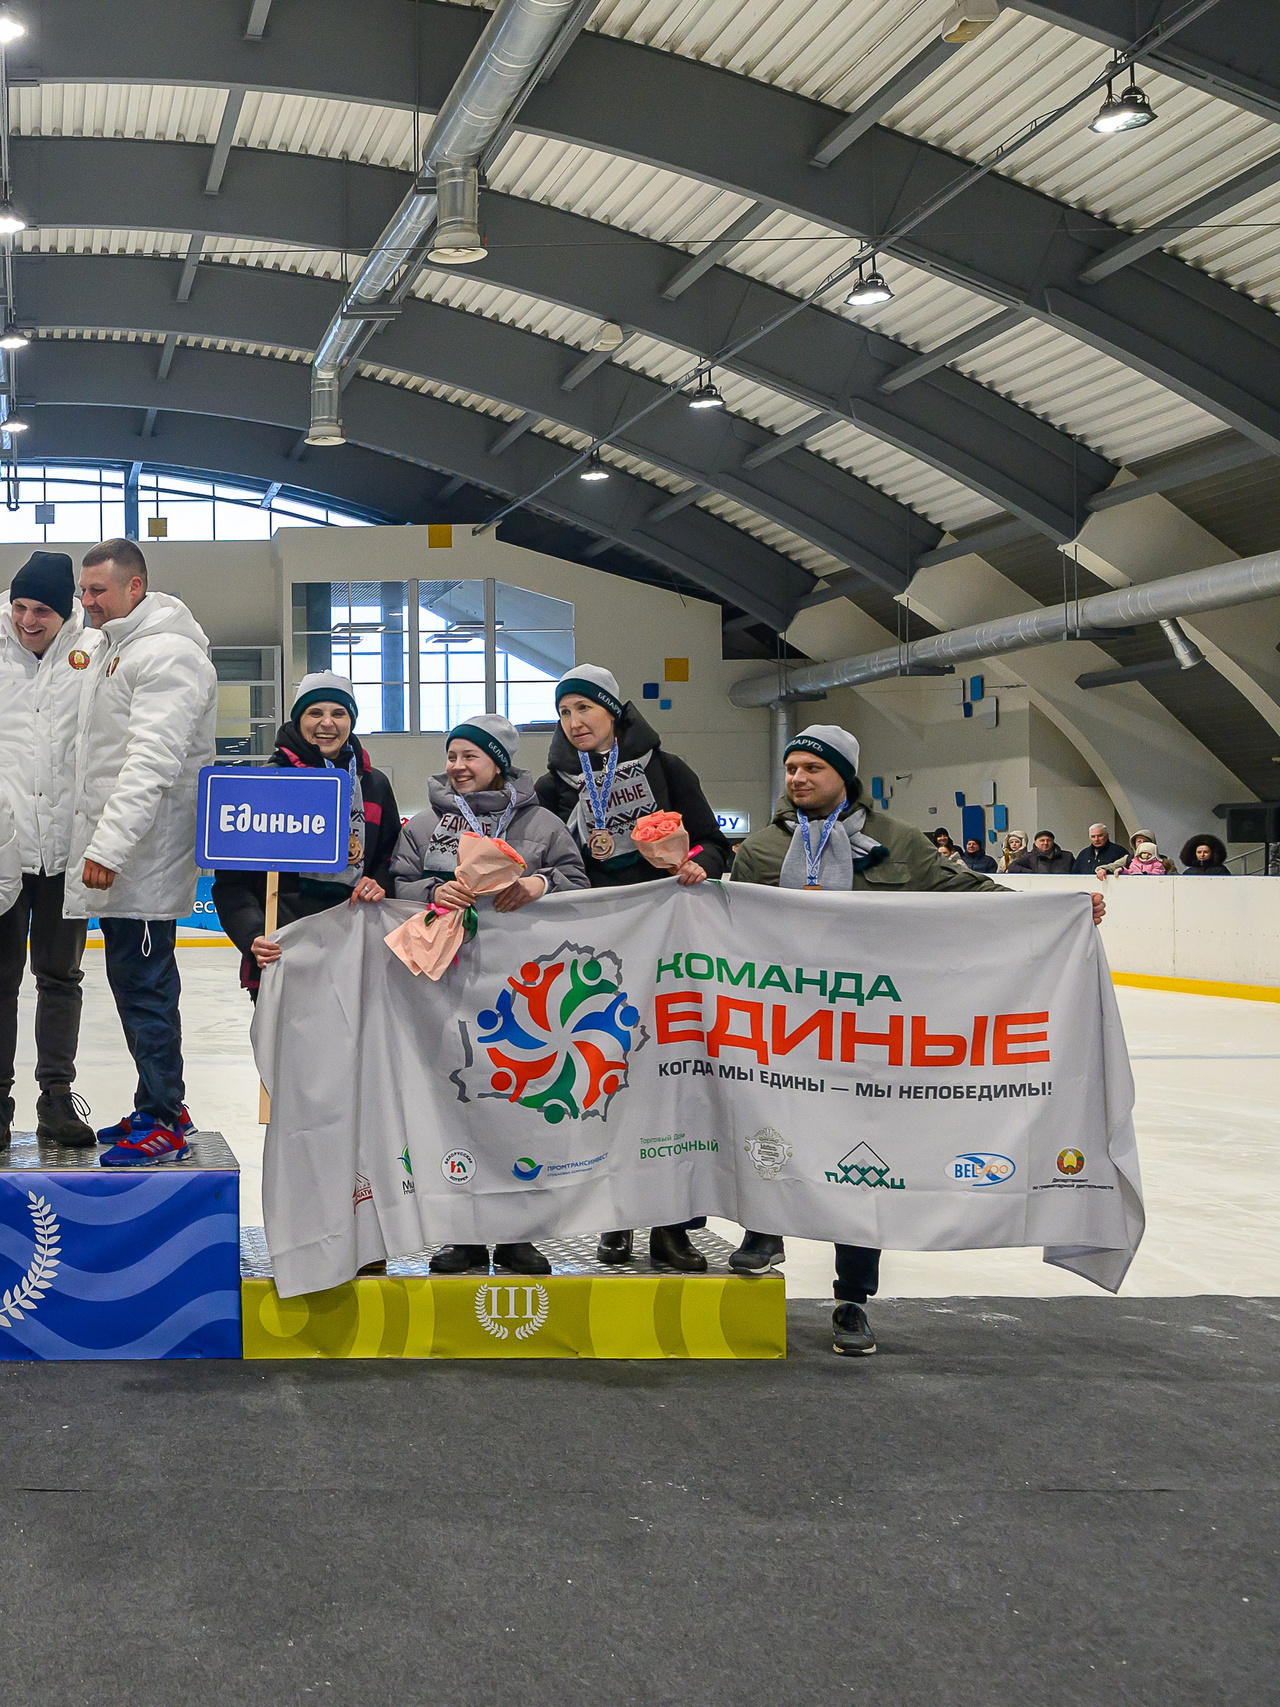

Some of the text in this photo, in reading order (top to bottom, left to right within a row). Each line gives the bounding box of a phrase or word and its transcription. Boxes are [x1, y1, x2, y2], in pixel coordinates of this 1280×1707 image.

[219, 803, 326, 835] Единые
[656, 952, 902, 1006] КОМАНДА
[655, 991, 1050, 1067] ЕДИНЫЕ
[658, 1059, 714, 1077] КОГДА
[719, 1064, 754, 1082] МЫ
[760, 1070, 825, 1093] ЕДИНЫ
[855, 1082, 892, 1099] МЫ
[899, 1081, 1052, 1102] НЕПОБЕДИМЫ!
[546, 1152, 609, 1171] ПРОМТРАНСИНВЕСТ
[639, 1138, 719, 1160] ВОСТОЧНЫЙ
[487, 1286, 537, 1319] III
